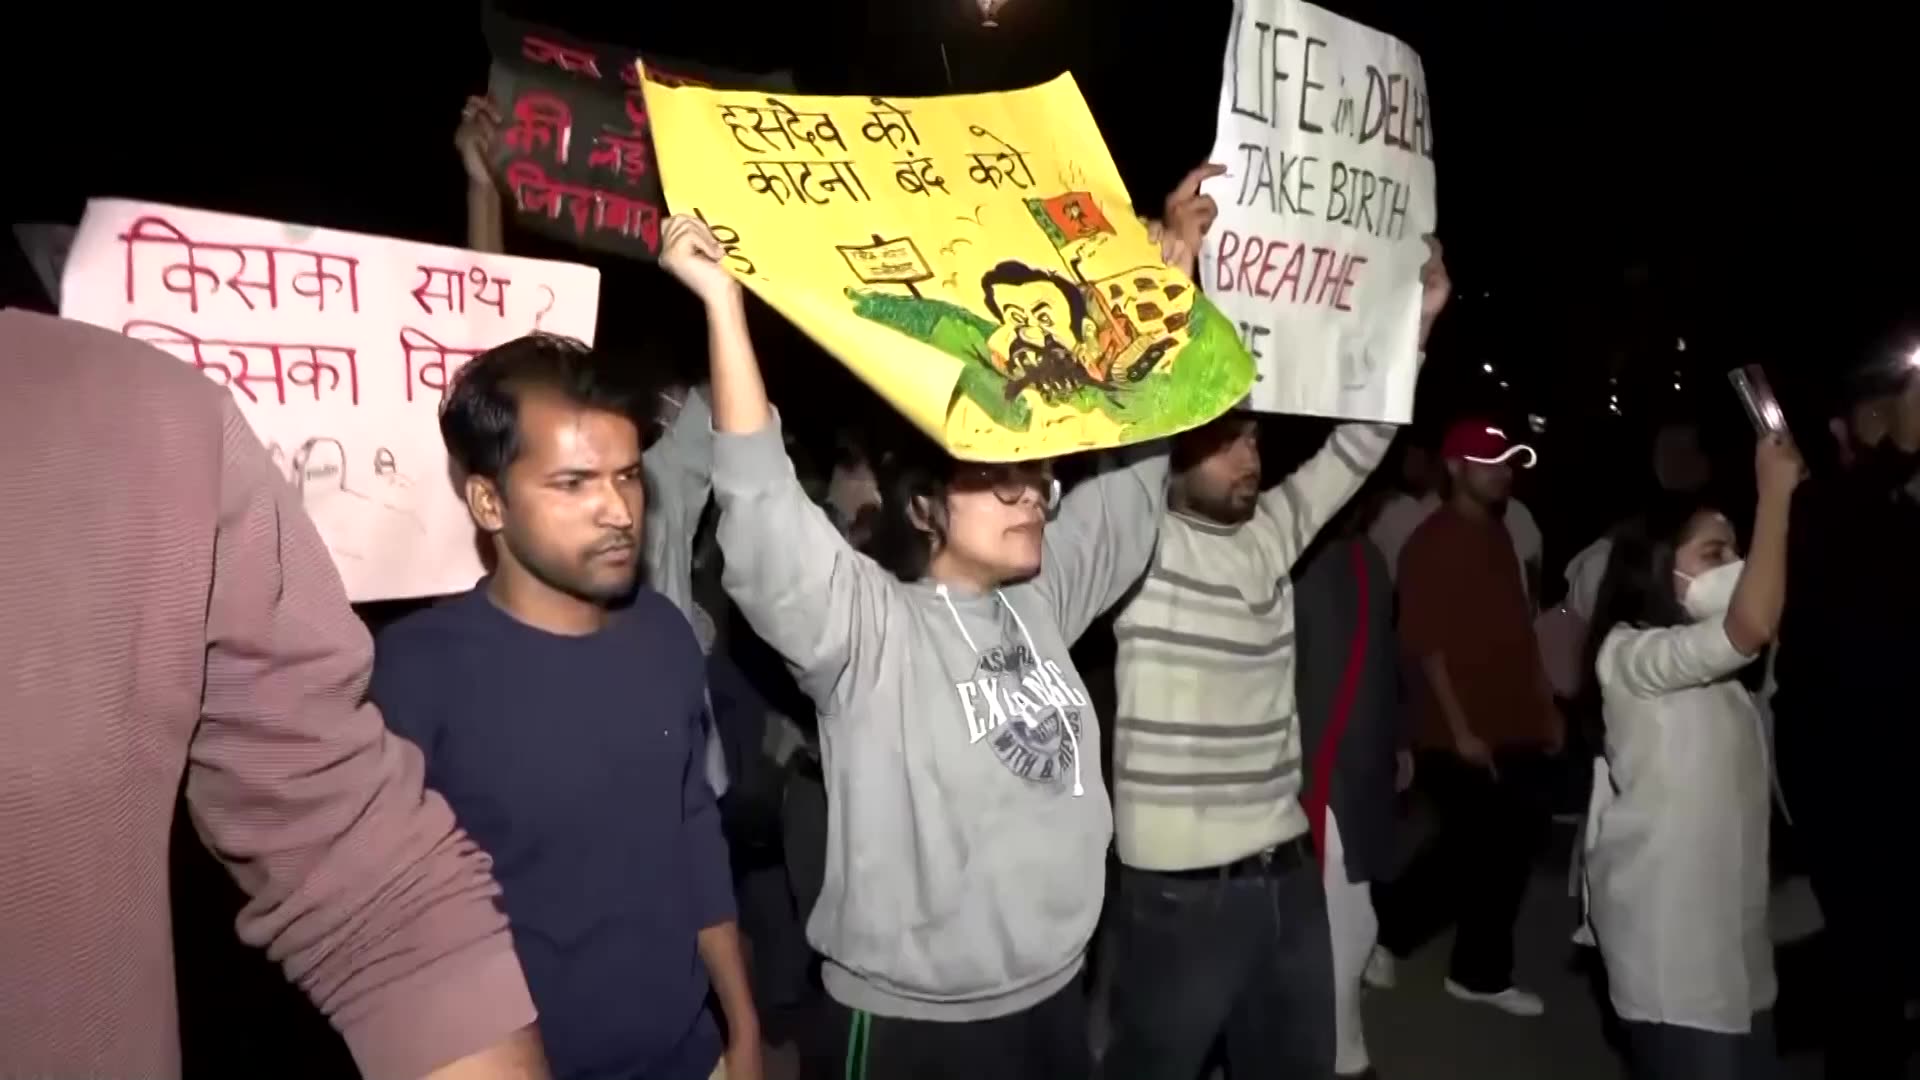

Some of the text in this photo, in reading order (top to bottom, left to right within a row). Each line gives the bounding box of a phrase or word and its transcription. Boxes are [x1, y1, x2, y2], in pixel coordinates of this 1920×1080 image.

[1231, 14, 1327, 133] LIFE
[717, 97, 920, 156] हसदेव को
[743, 125, 1036, 205] काटना बंद करो
[1236, 143, 1411, 240] TAKE BIRTH
[118, 216, 360, 314] किसका
[411, 256, 511, 318] साथ
[1216, 230, 1368, 312] BREATHE
